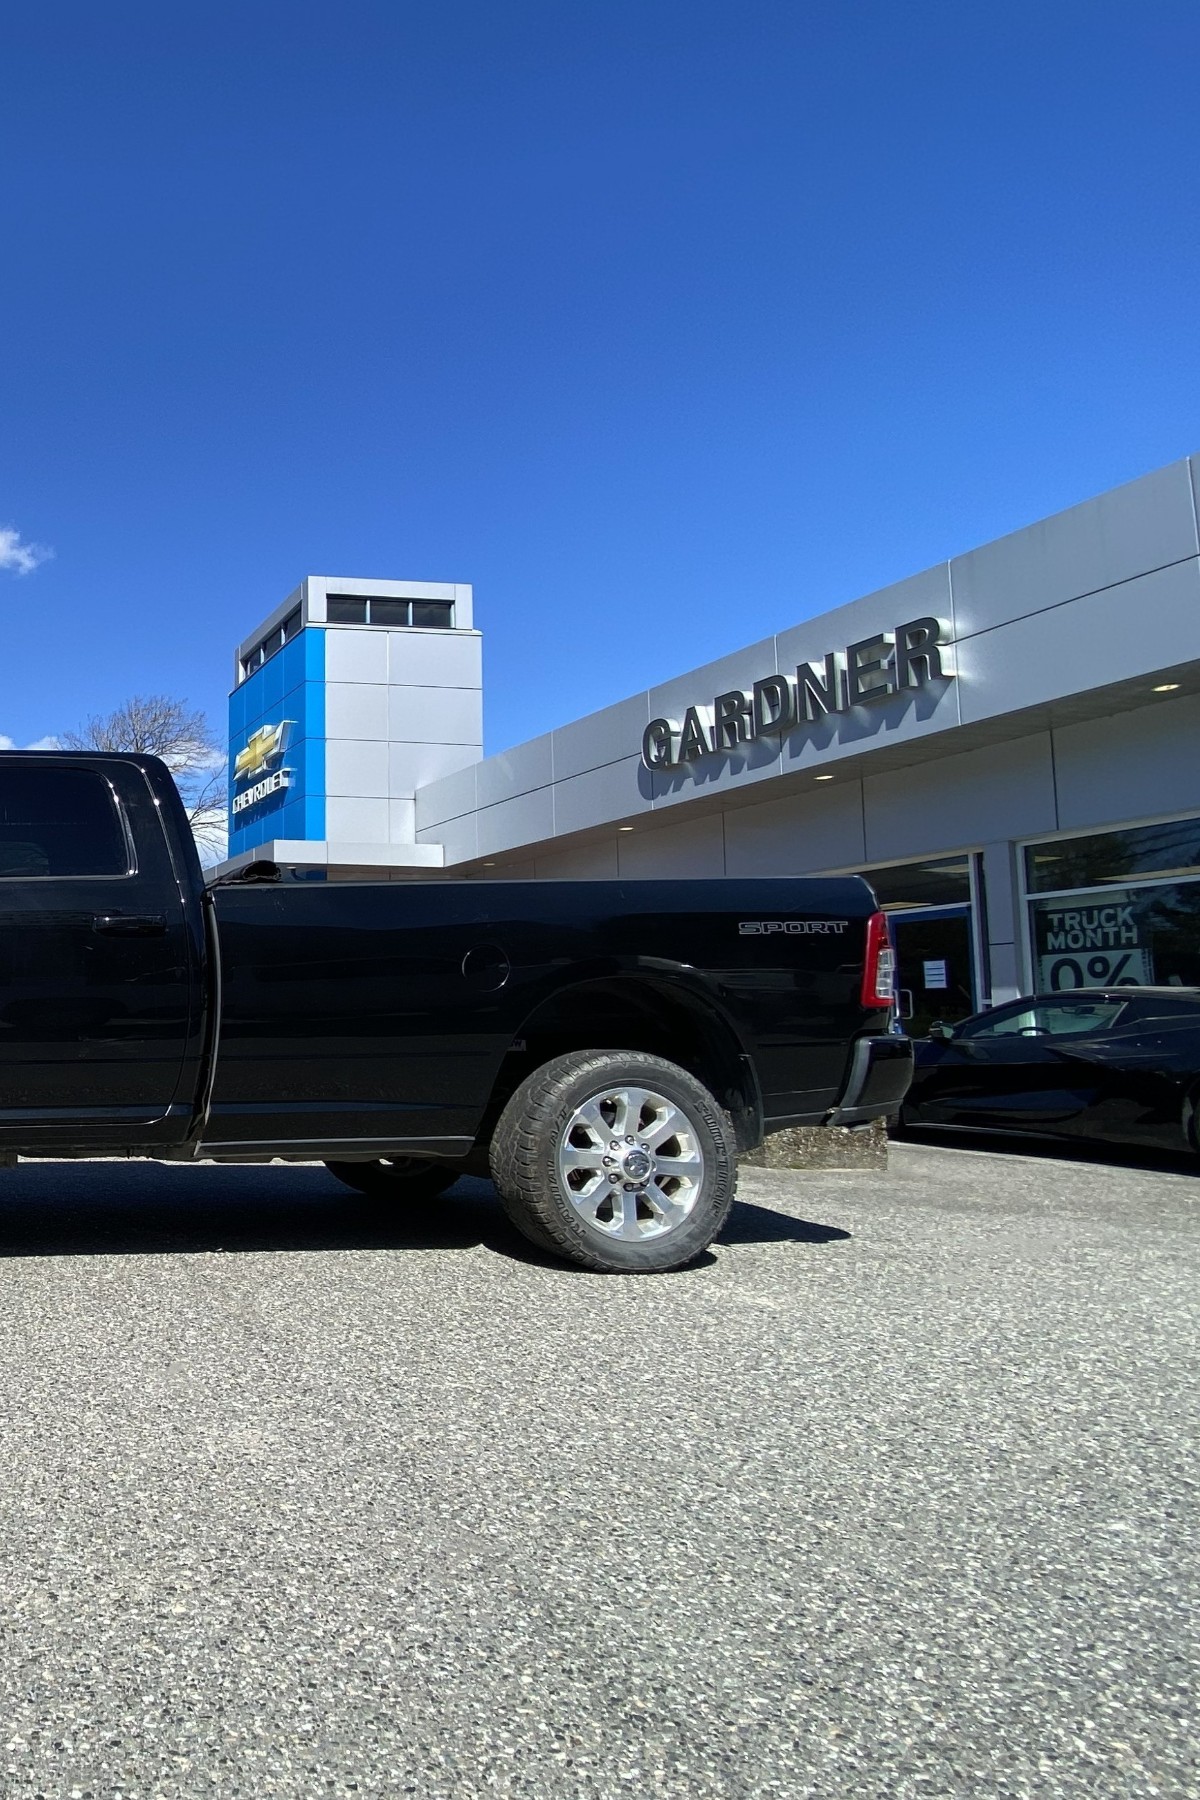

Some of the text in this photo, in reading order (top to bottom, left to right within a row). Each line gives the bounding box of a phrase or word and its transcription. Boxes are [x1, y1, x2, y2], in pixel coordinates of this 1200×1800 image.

[642, 617, 956, 771] GARDNER
[738, 921, 848, 935] SPORT
[1048, 907, 1135, 931] TRUCK
[1047, 926, 1138, 949] MONTH
[1051, 954, 1139, 991] 0%
